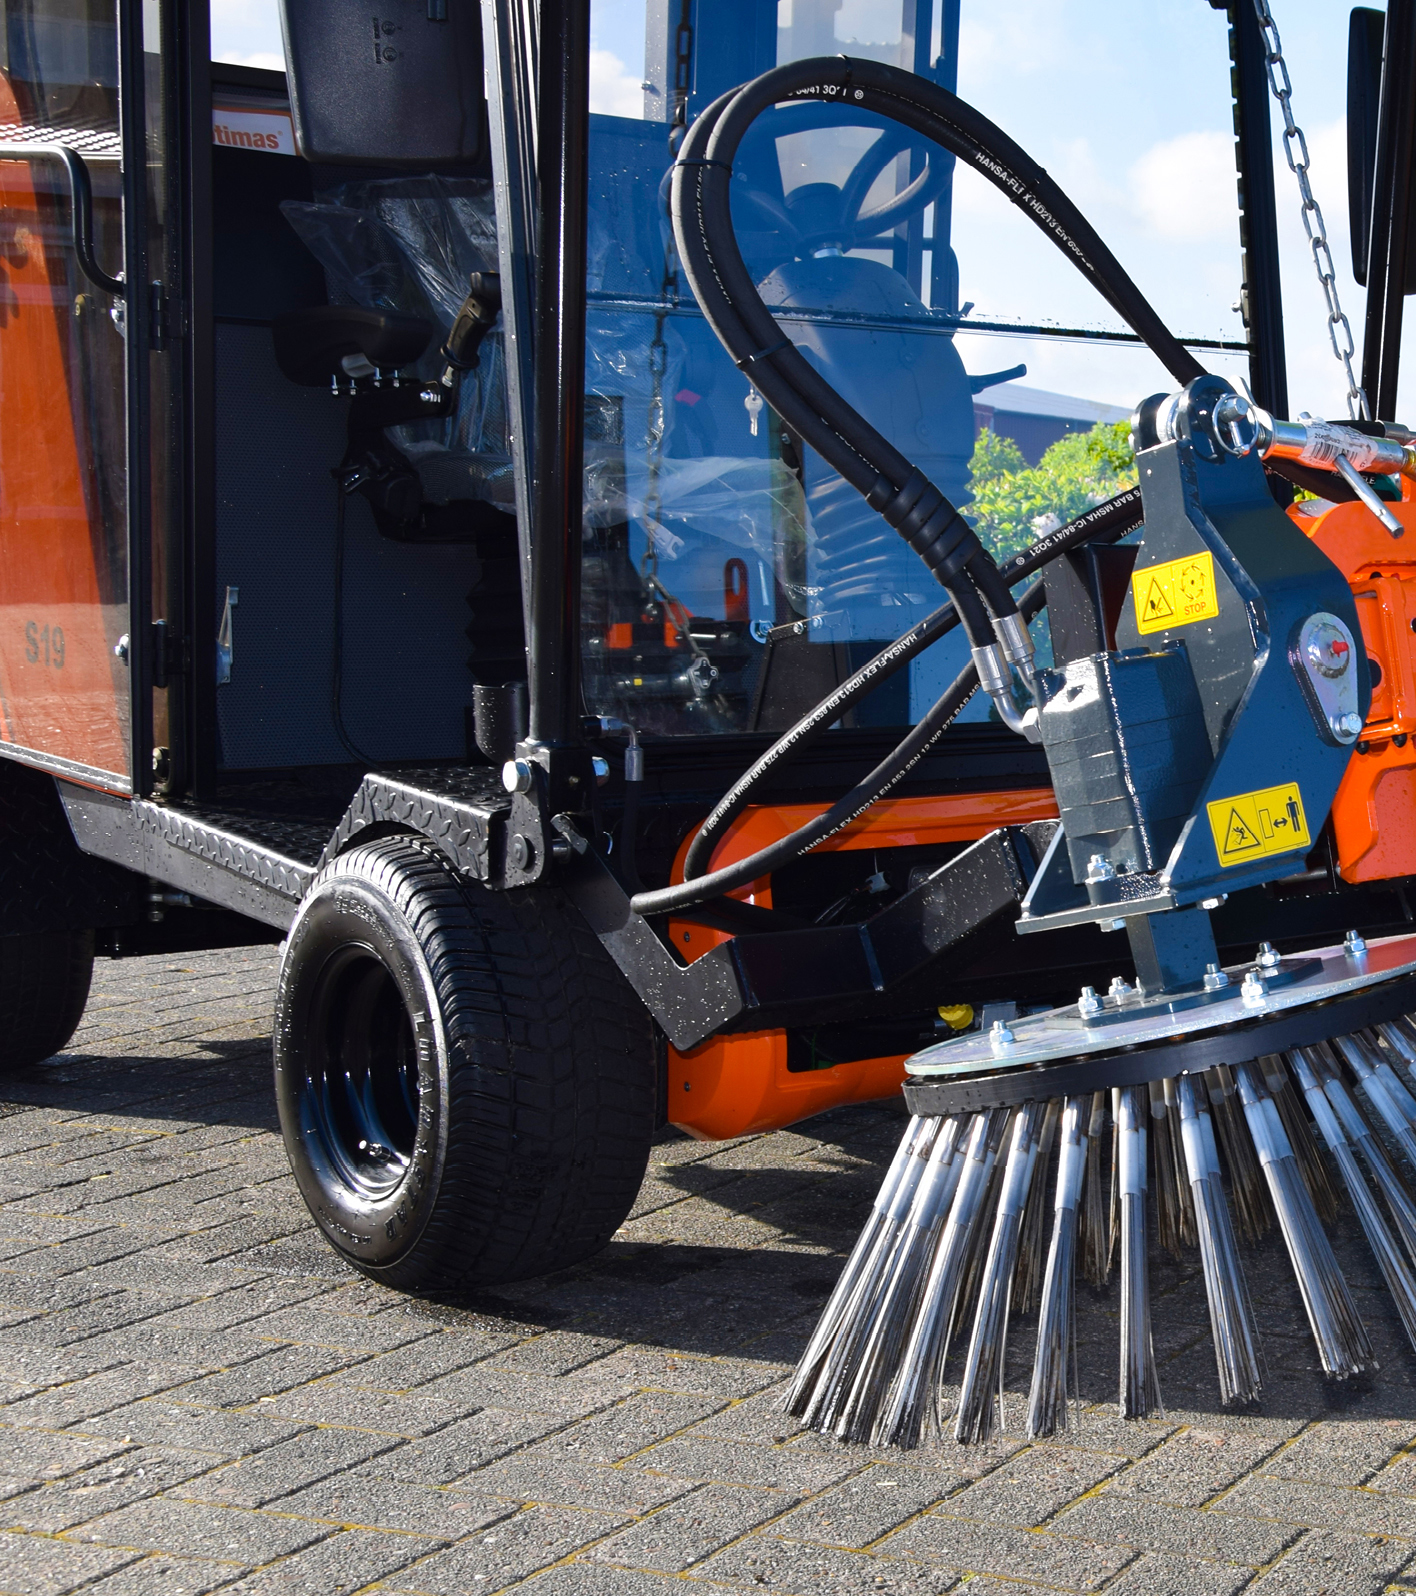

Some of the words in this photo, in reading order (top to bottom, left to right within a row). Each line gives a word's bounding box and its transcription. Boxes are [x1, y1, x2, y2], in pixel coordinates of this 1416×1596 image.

[822, 85, 847, 97] 3Q1
[213, 124, 280, 150] timas
[1113, 494, 1134, 508] BAR
[1086, 503, 1114, 522] MSHA
[1184, 601, 1206, 616] STOP
[25, 620, 66, 670] S19
[865, 633, 918, 679] HANSA-FLEX
[797, 816, 853, 856] HANSA-FLEX
[879, 783, 892, 796] EN
